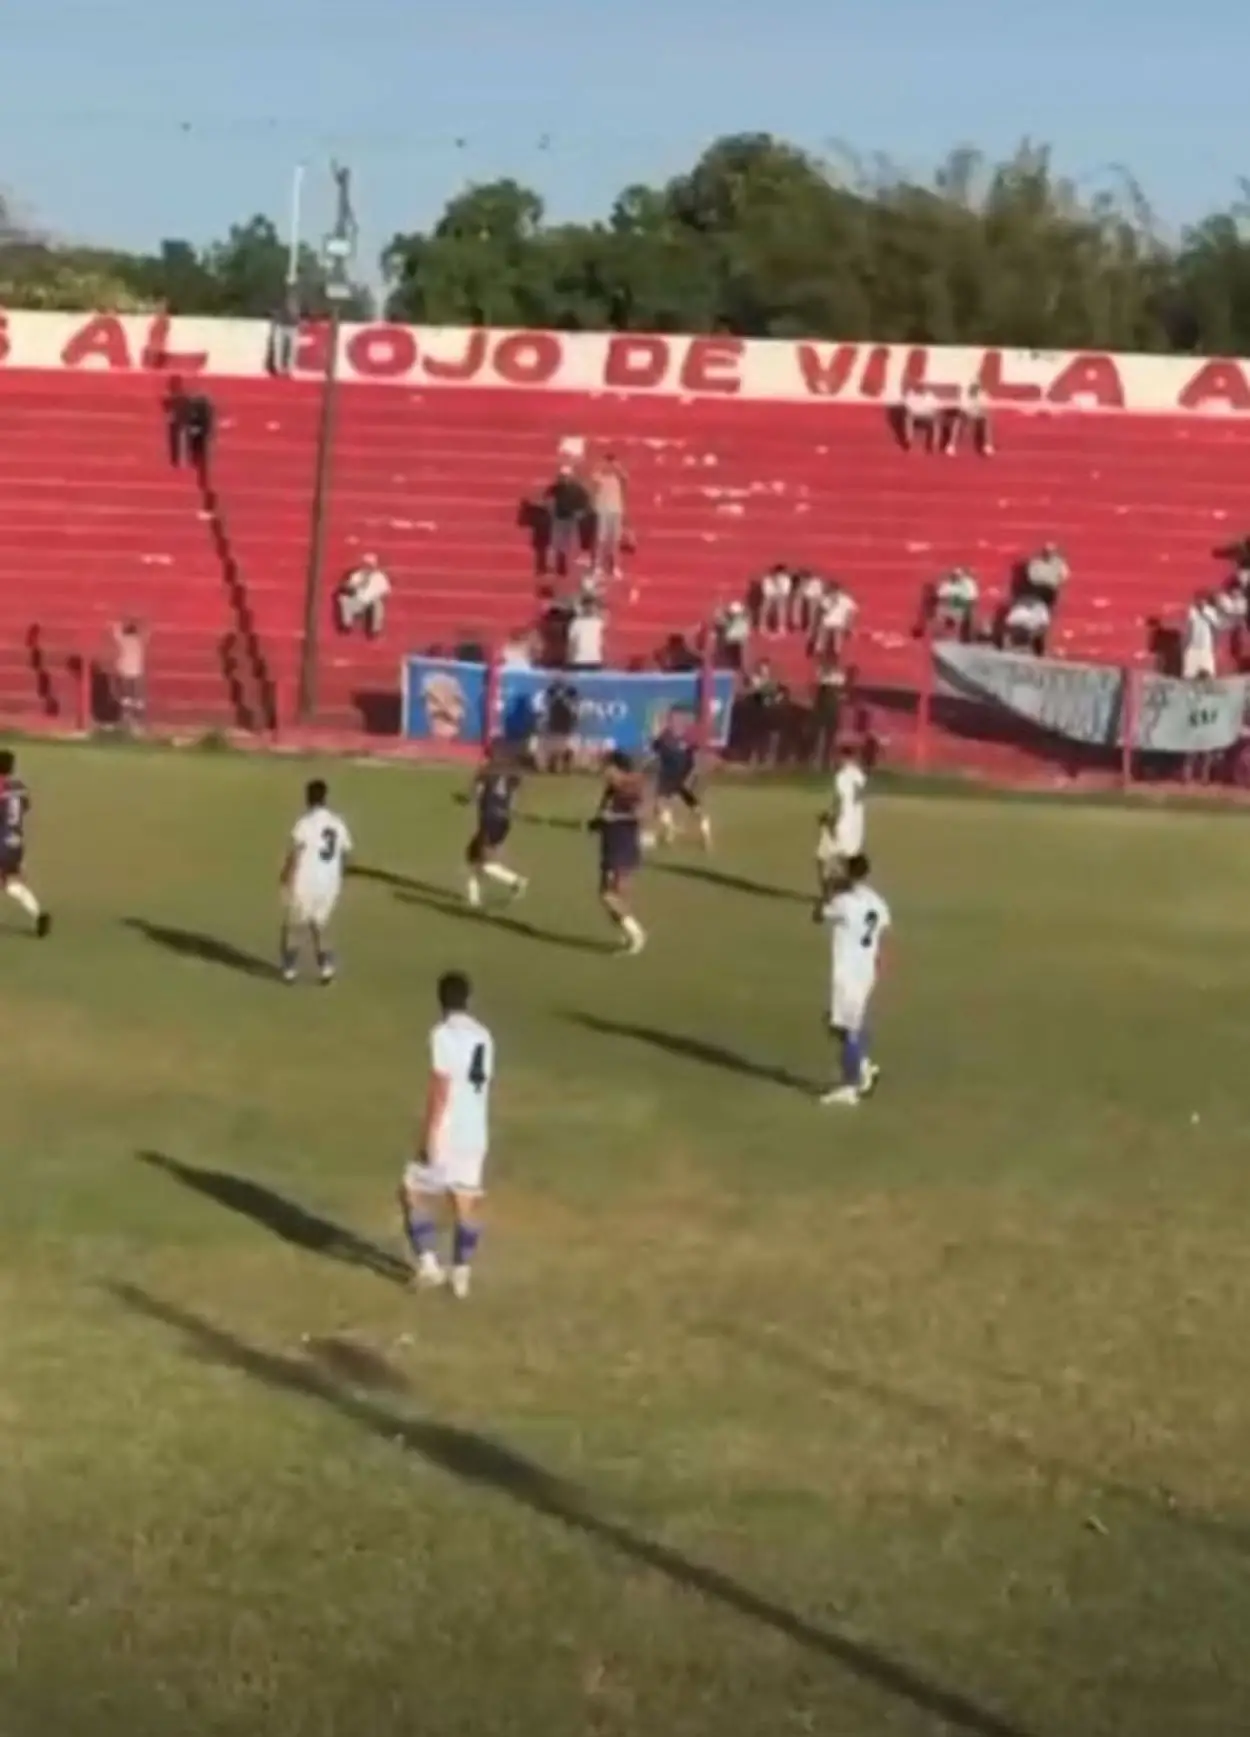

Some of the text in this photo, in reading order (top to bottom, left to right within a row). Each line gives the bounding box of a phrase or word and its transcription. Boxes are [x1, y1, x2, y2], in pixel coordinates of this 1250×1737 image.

[60, 314, 208, 371] AL
[603, 333, 744, 394] DE
[798, 344, 1125, 408] VILLA
[319, 827, 338, 863] 3
[468, 1043, 487, 1094] 4
